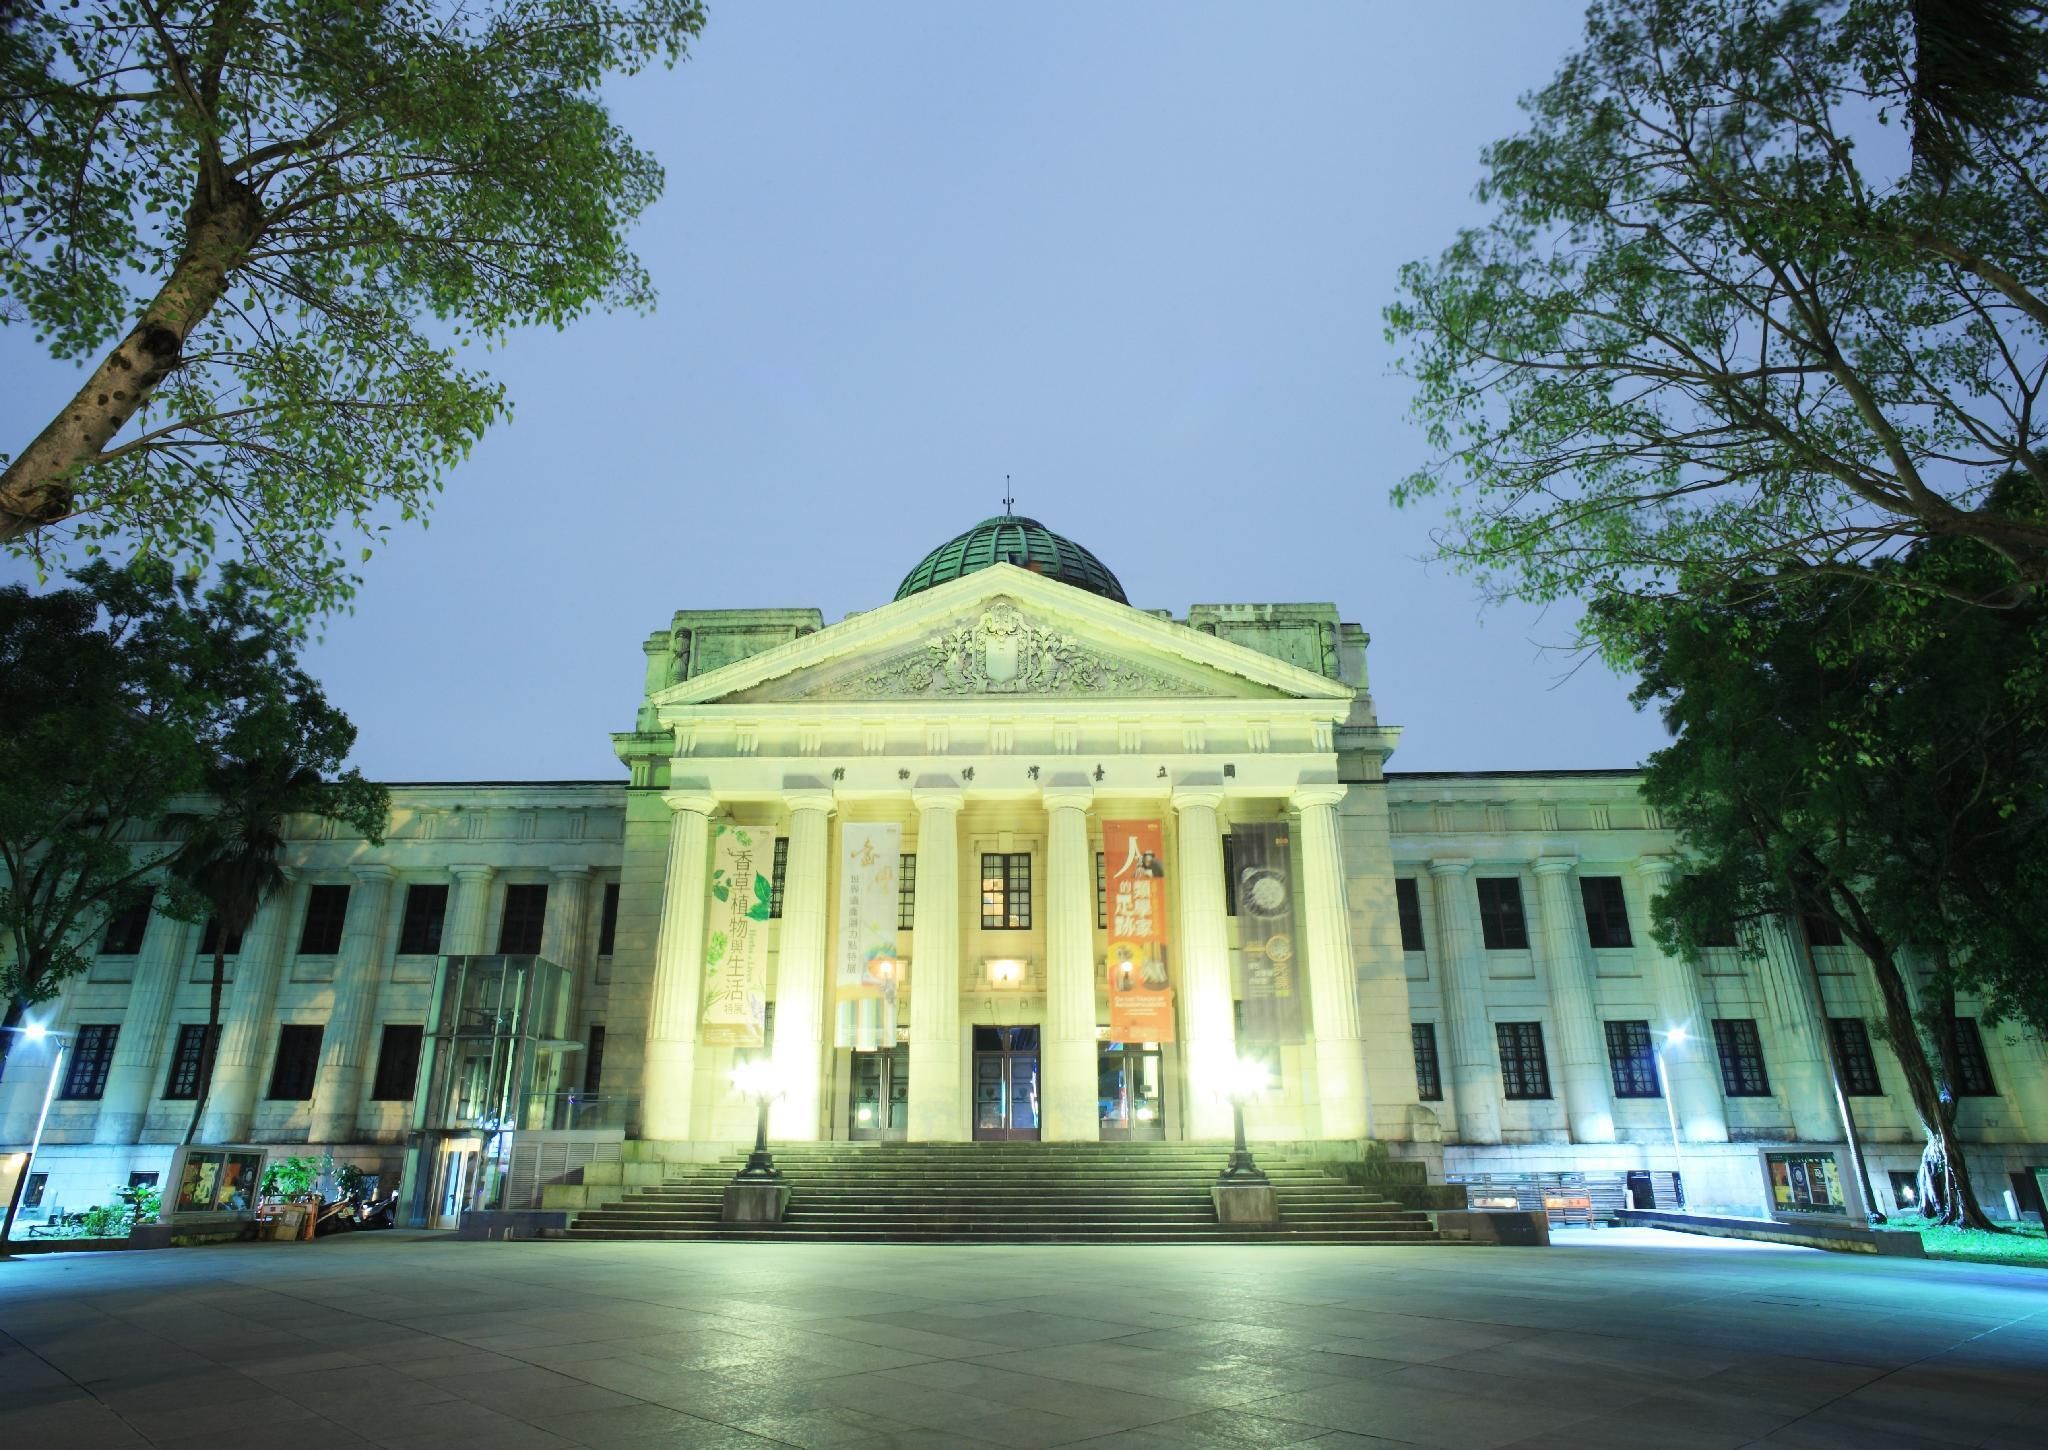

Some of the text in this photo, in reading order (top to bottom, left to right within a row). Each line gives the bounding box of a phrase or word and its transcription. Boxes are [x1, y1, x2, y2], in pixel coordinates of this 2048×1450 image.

[725, 848, 753, 1001] 香草植物與生活
